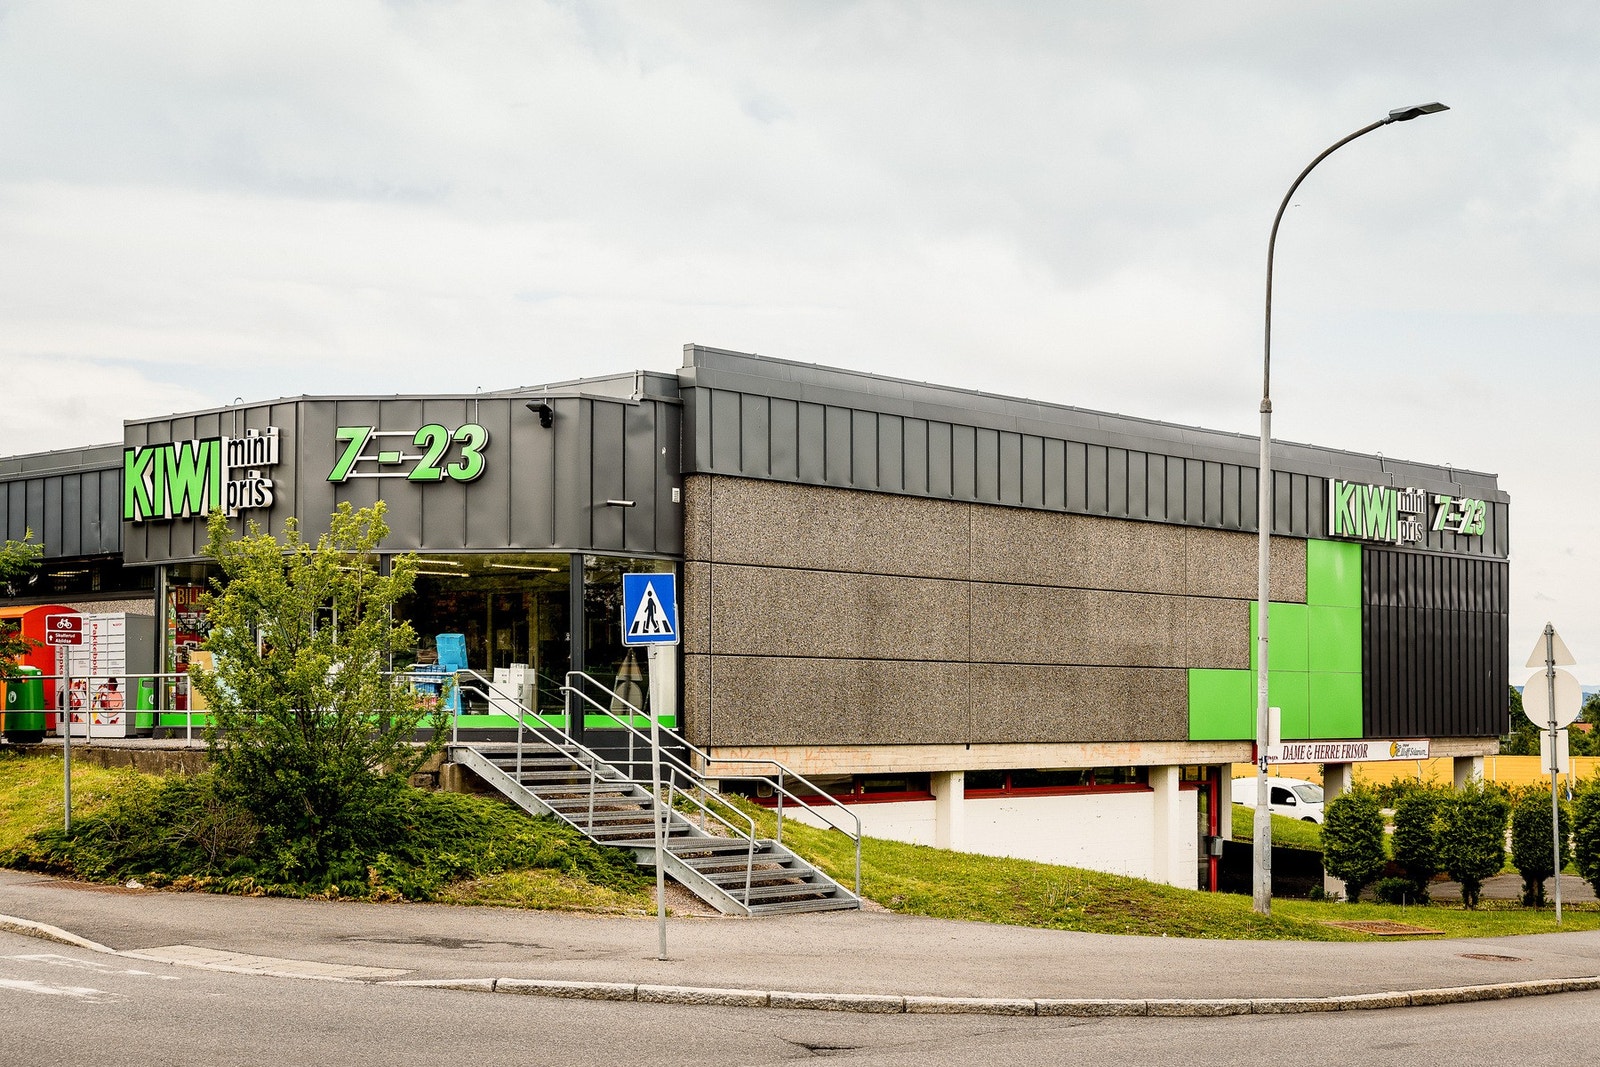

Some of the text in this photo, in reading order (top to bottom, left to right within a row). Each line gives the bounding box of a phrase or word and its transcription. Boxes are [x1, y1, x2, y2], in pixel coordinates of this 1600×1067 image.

[227, 427, 275, 468] mini
[123, 436, 222, 522] KIWI
[227, 470, 270, 509] pris
[1334, 480, 1397, 542] KIWI
[1398, 487, 1426, 513] mini
[1399, 516, 1424, 545] pris
[1282, 744, 1305, 760] DAME
[1306, 744, 1312, 759] &
[1314, 744, 1340, 760] HERRE
[1340, 743, 1369, 759] FRISØR
